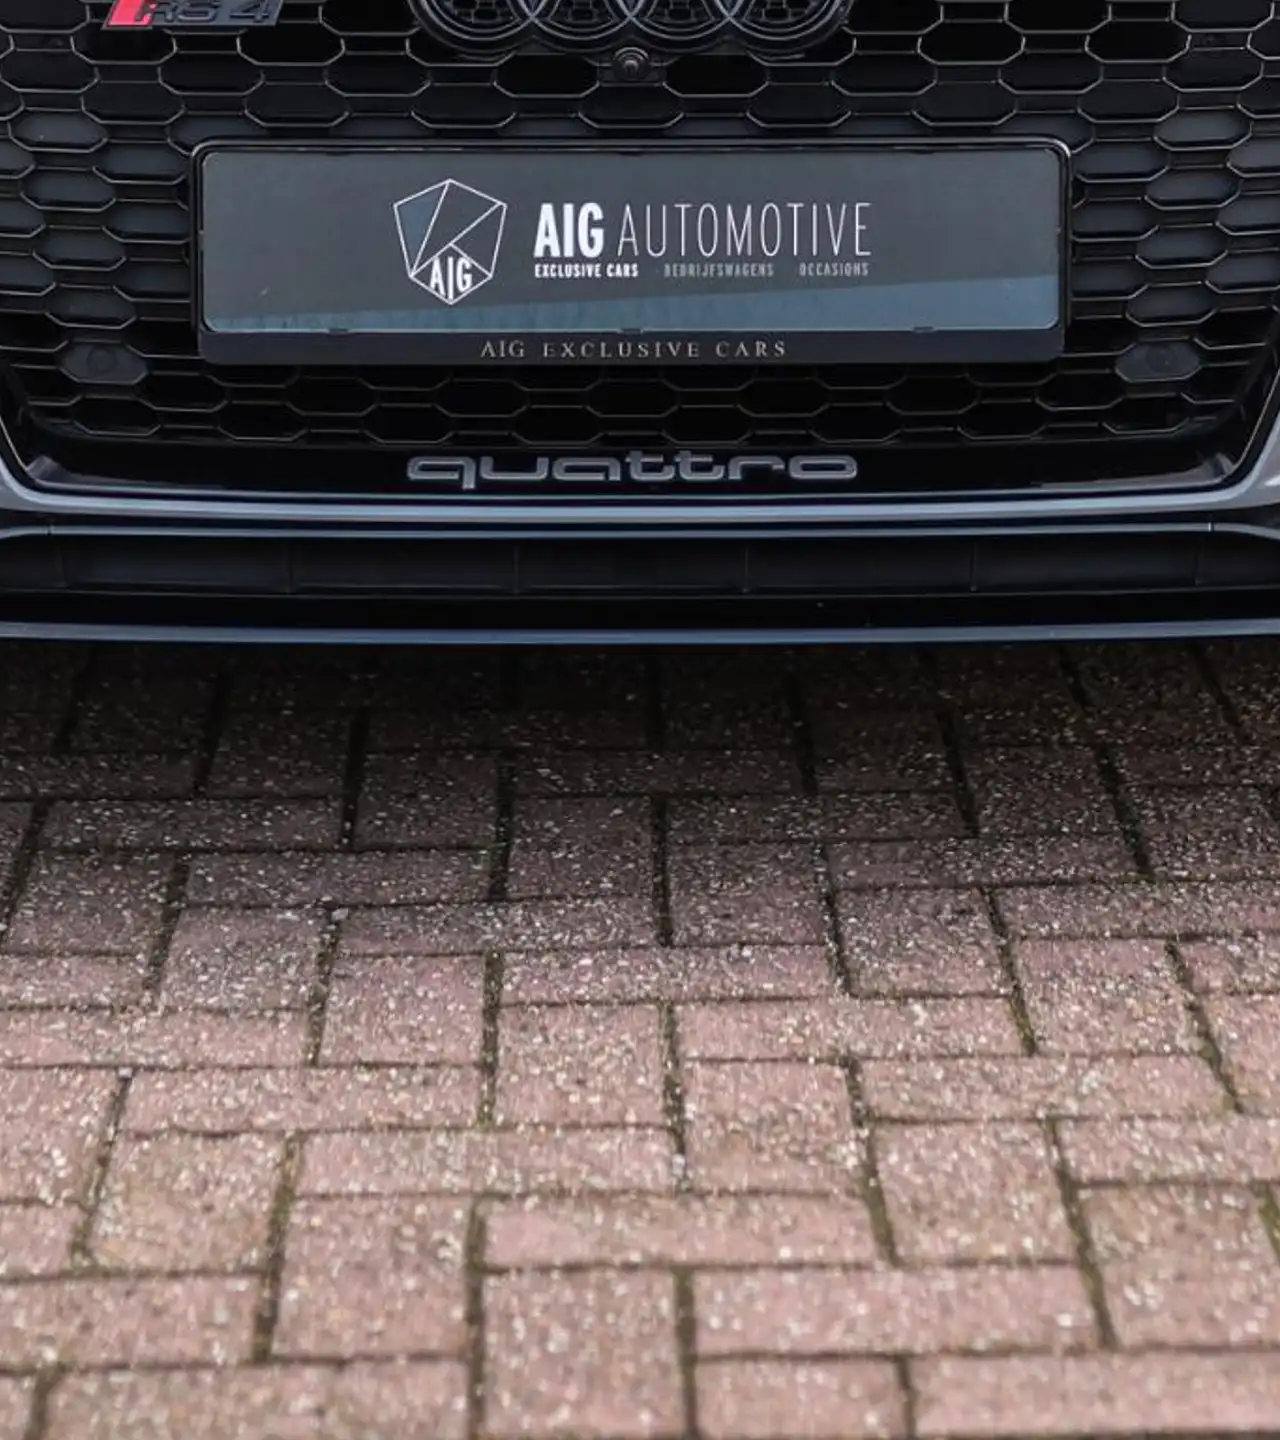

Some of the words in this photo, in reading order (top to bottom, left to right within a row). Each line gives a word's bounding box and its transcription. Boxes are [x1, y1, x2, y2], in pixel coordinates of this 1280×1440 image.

[532, 201, 605, 258] AIG
[616, 202, 872, 257] AUTOMOTIVE
[429, 256, 473, 300] AIG
[534, 262, 601, 279] EXCLUSIVE
[605, 262, 639, 279] CARS
[663, 262, 774, 278] BEDRIJFSWAGENS
[798, 261, 869, 277] OCCASIONS
[480, 339, 525, 359] AIG
[542, 340, 700, 359] EXCLUSIVE
[715, 339, 786, 359] CARS
[406, 449, 858, 489] quattro
